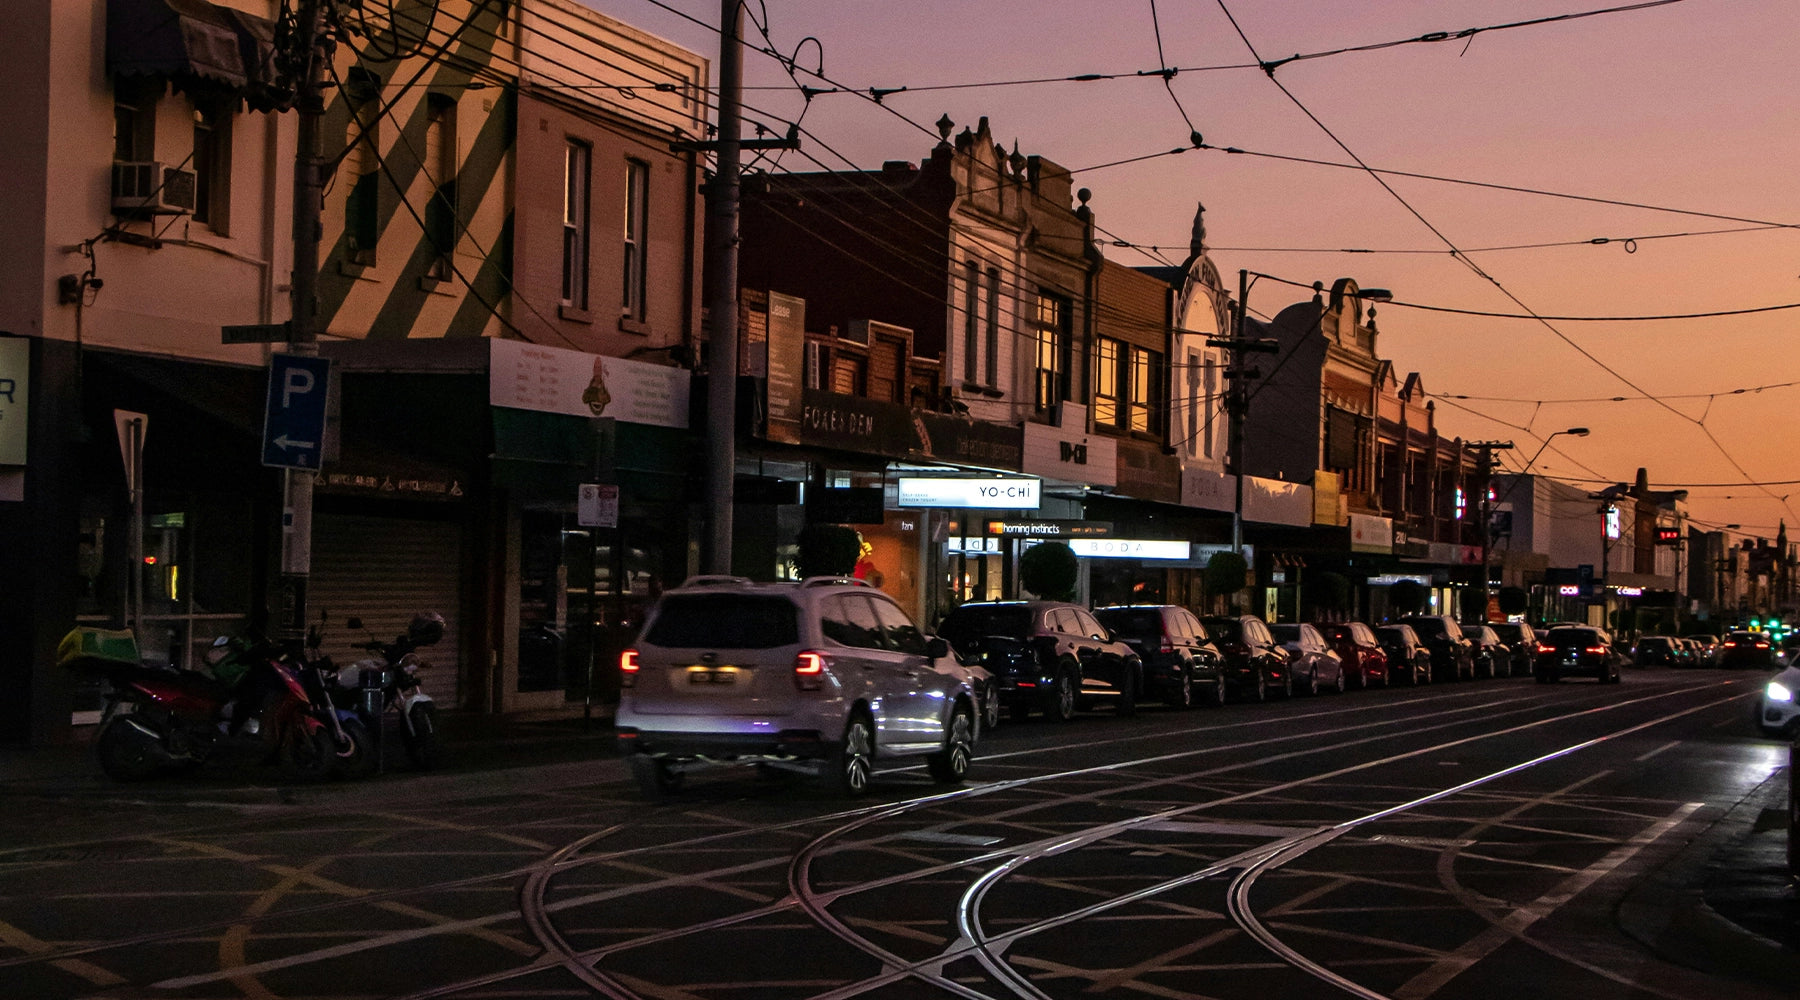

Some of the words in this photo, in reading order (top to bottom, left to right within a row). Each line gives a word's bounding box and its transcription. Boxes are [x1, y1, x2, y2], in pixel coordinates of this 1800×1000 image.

[283, 367, 315, 408] P
[849, 413, 873, 435] DEN
[1004, 523, 1030, 535] homing
[1031, 523, 1060, 534] instincts
[1090, 542, 1143, 552] BODA
[1582, 568, 1590, 577] P
